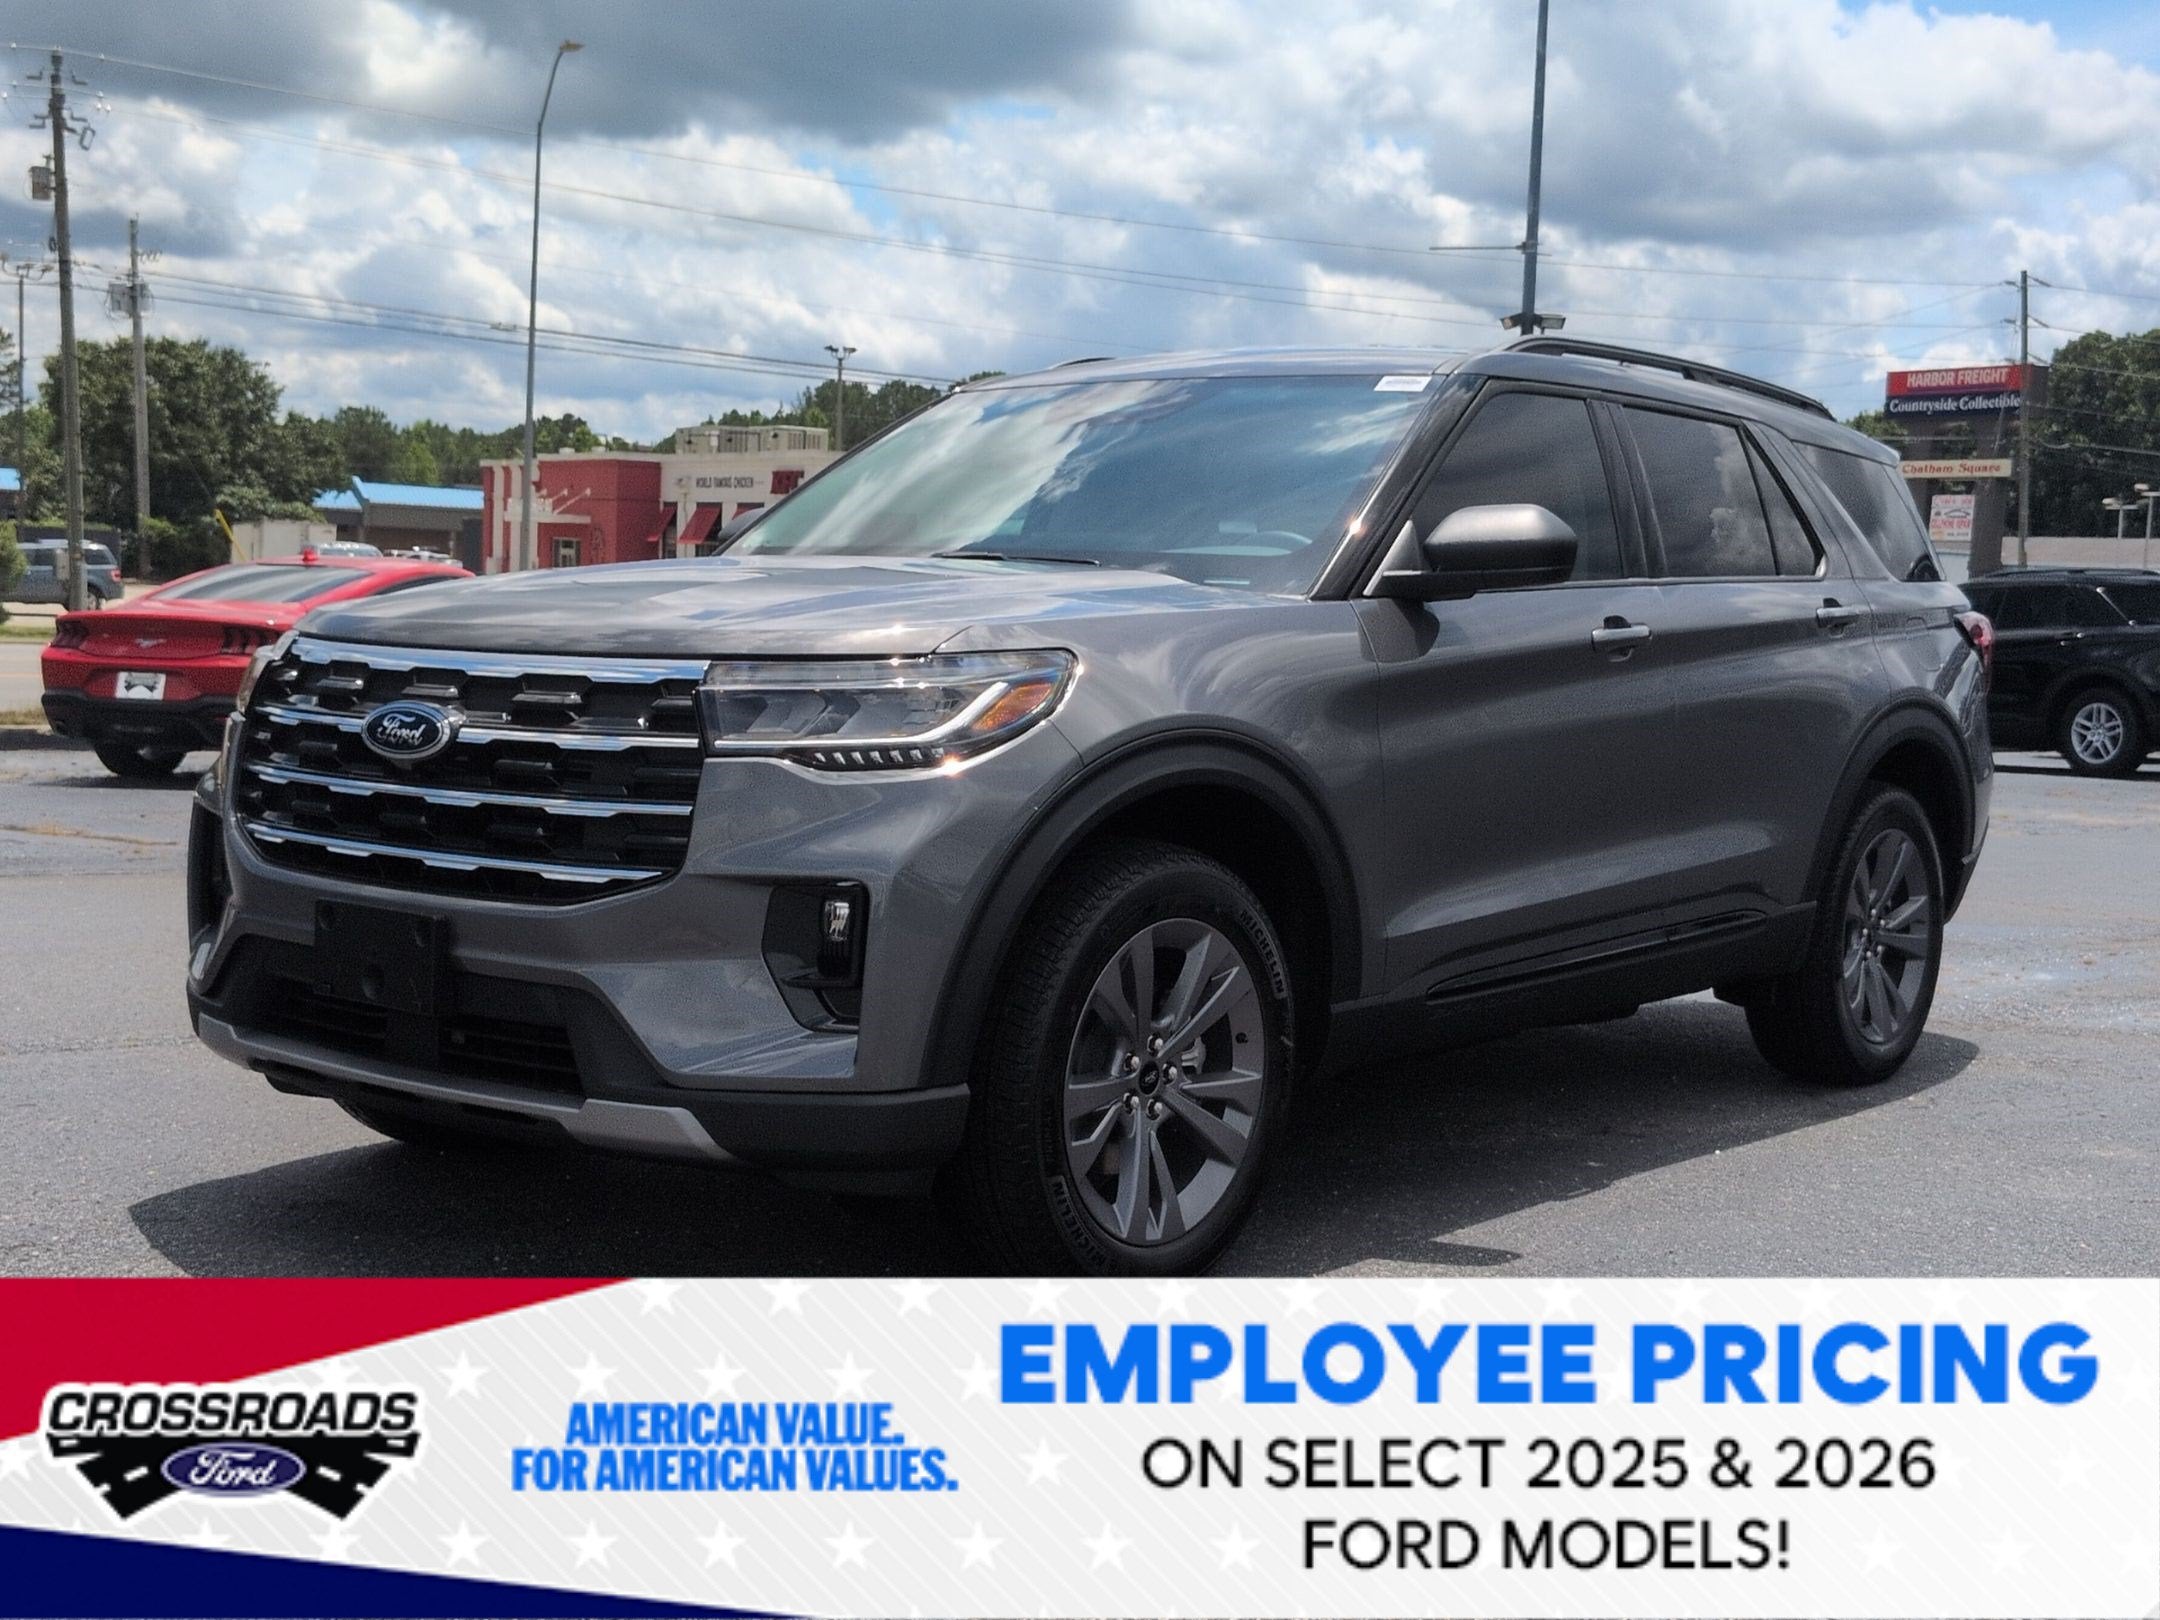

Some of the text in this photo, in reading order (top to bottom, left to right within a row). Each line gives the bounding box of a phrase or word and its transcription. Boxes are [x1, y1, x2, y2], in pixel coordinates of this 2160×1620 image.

[1906, 367, 2009, 388] HARBOR FREIGHT
[1889, 393, 2024, 415] Countryside Collectible
[1903, 463, 2001, 474] Chatham Square
[376, 712, 427, 746] Ford
[1239, 909, 1286, 994] MICHELIN
